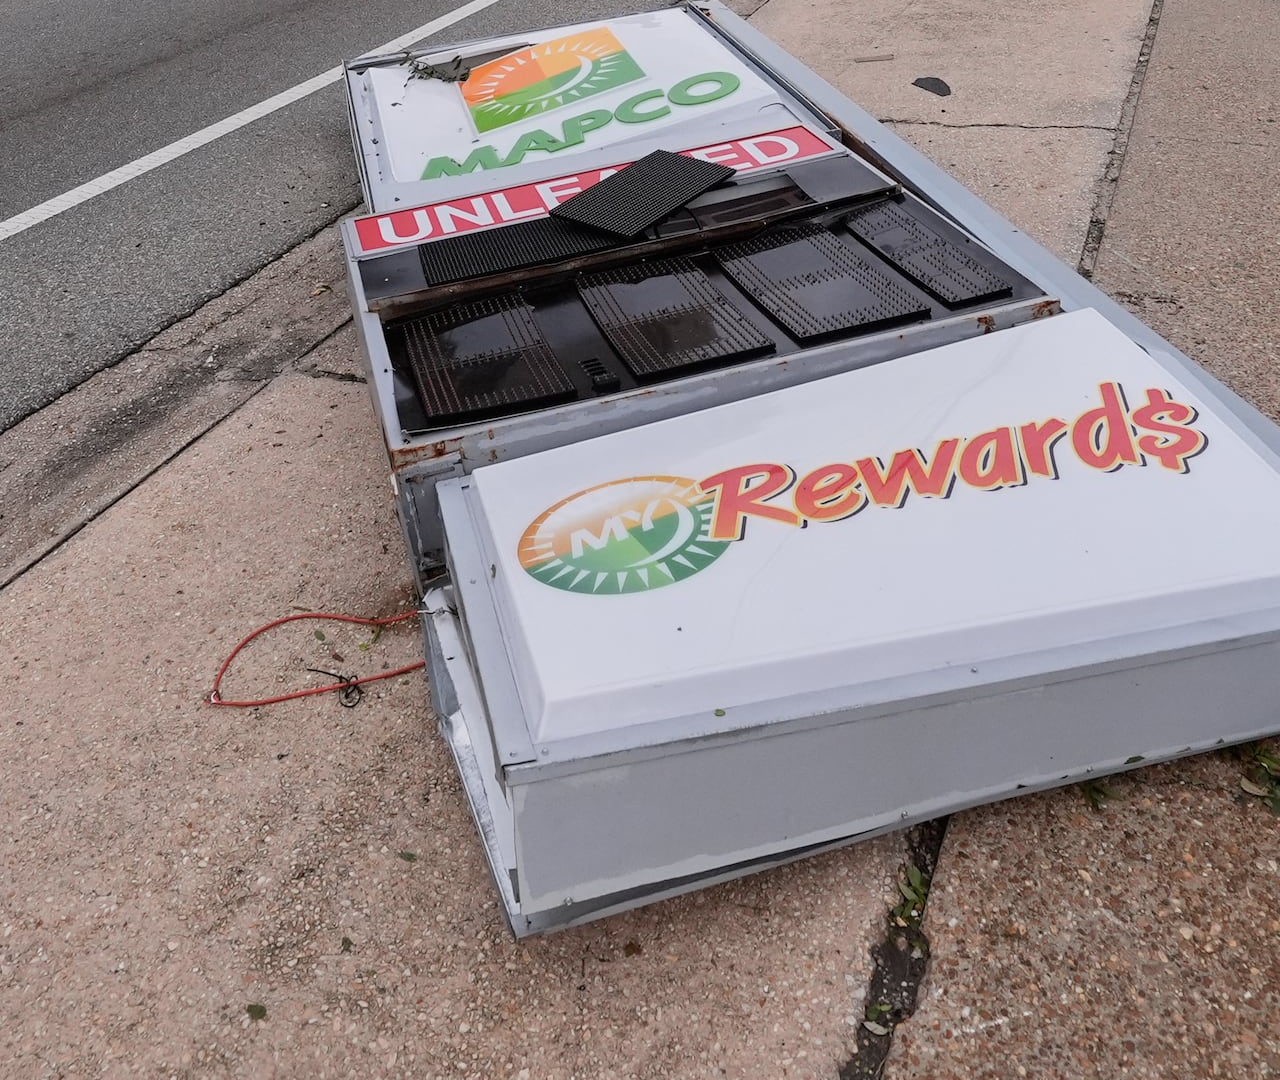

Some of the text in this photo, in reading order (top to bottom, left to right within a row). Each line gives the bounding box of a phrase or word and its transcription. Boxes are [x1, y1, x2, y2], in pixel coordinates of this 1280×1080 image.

[420, 71, 741, 181] MAPCO
[376, 135, 801, 245] UNLEED
[570, 499, 676, 559] MY
